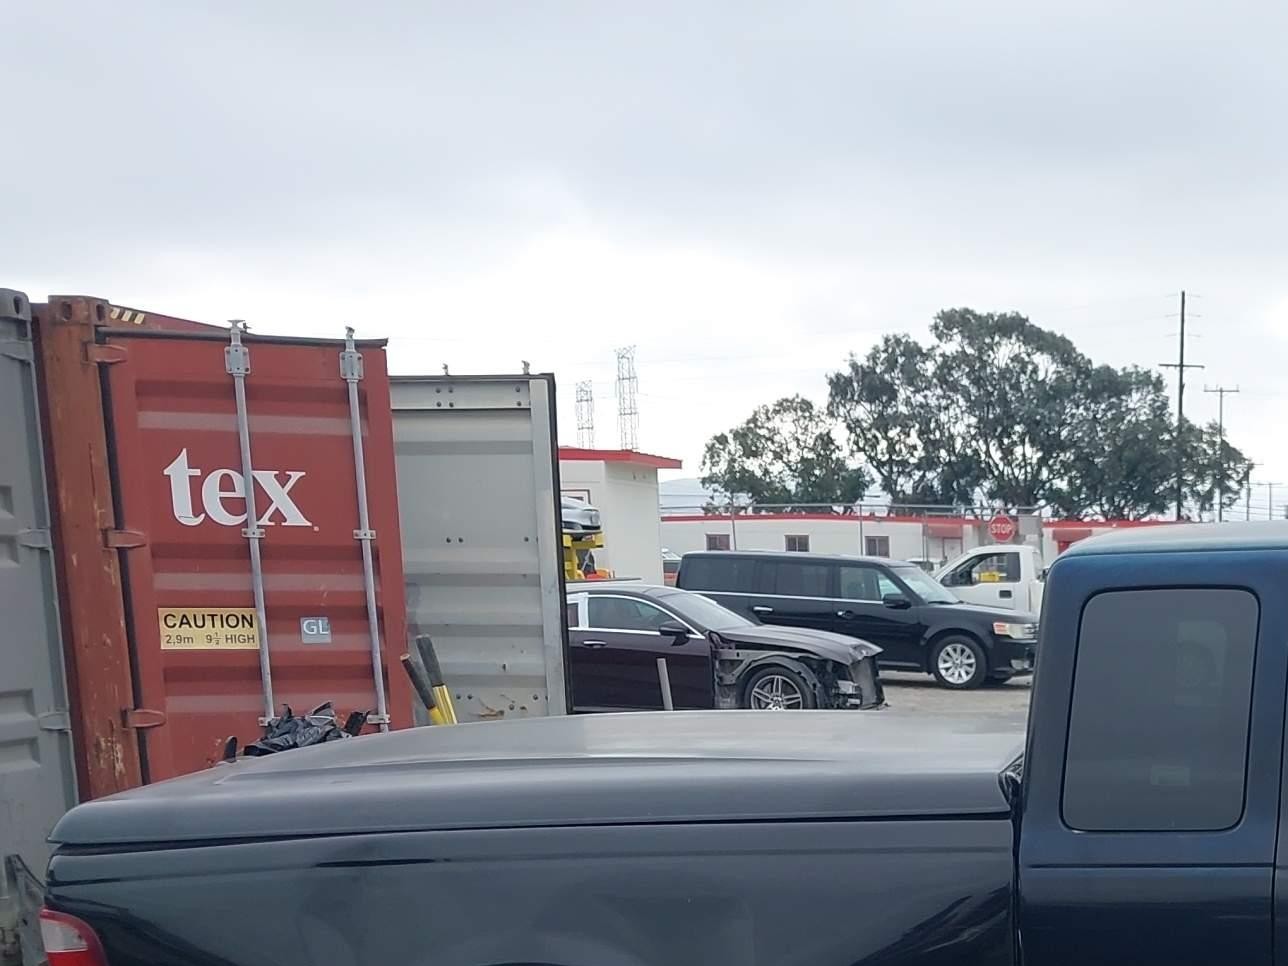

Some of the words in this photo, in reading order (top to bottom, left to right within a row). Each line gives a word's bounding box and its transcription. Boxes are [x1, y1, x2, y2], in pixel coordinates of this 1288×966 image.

[991, 524, 1012, 534] STOP
[163, 614, 254, 628] CAUTION
[303, 620, 329, 635] GL
[225, 634, 255, 644] HIGH
